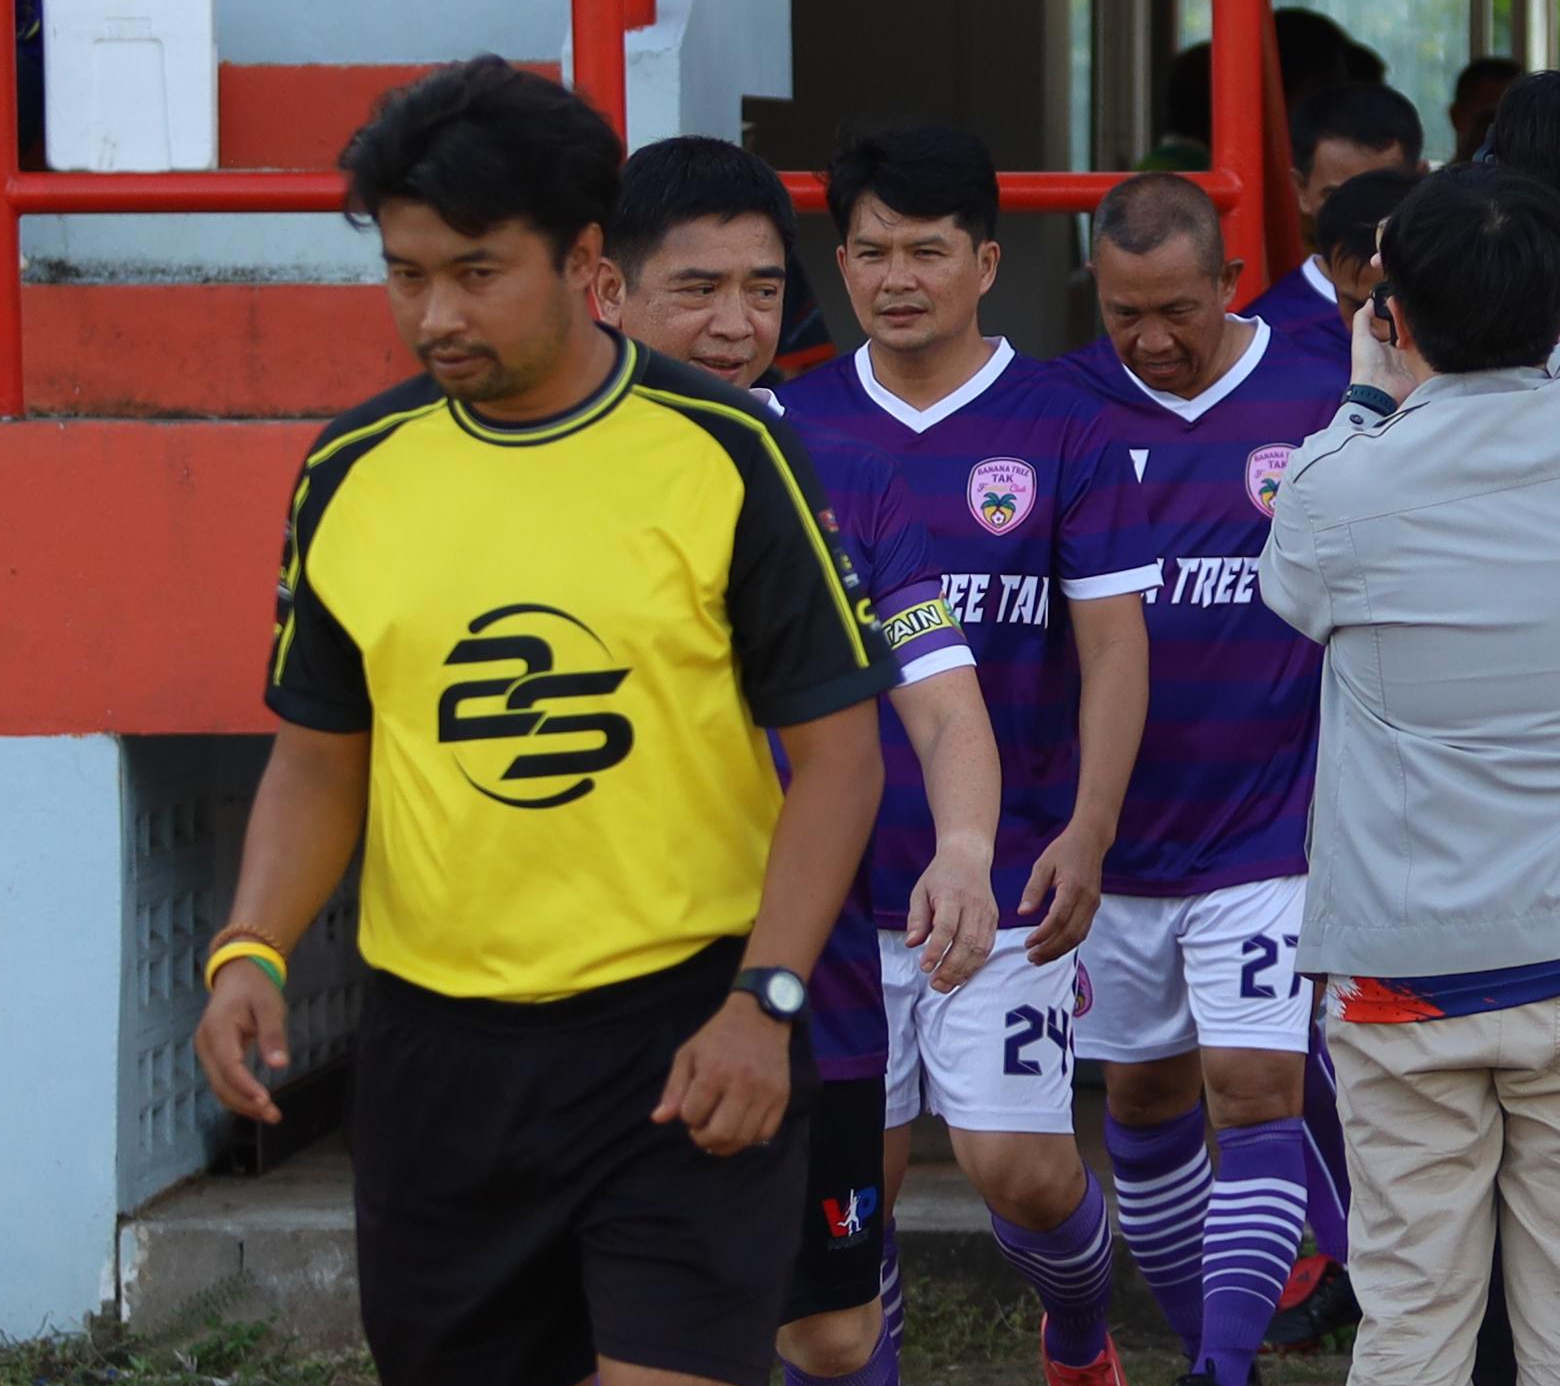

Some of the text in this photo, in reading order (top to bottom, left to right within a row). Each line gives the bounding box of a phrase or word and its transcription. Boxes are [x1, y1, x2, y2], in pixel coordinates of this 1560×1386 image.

[992, 474, 1014, 483] TAK
[1172, 557, 1261, 609] TREE
[1002, 1003, 1070, 1077] 24
